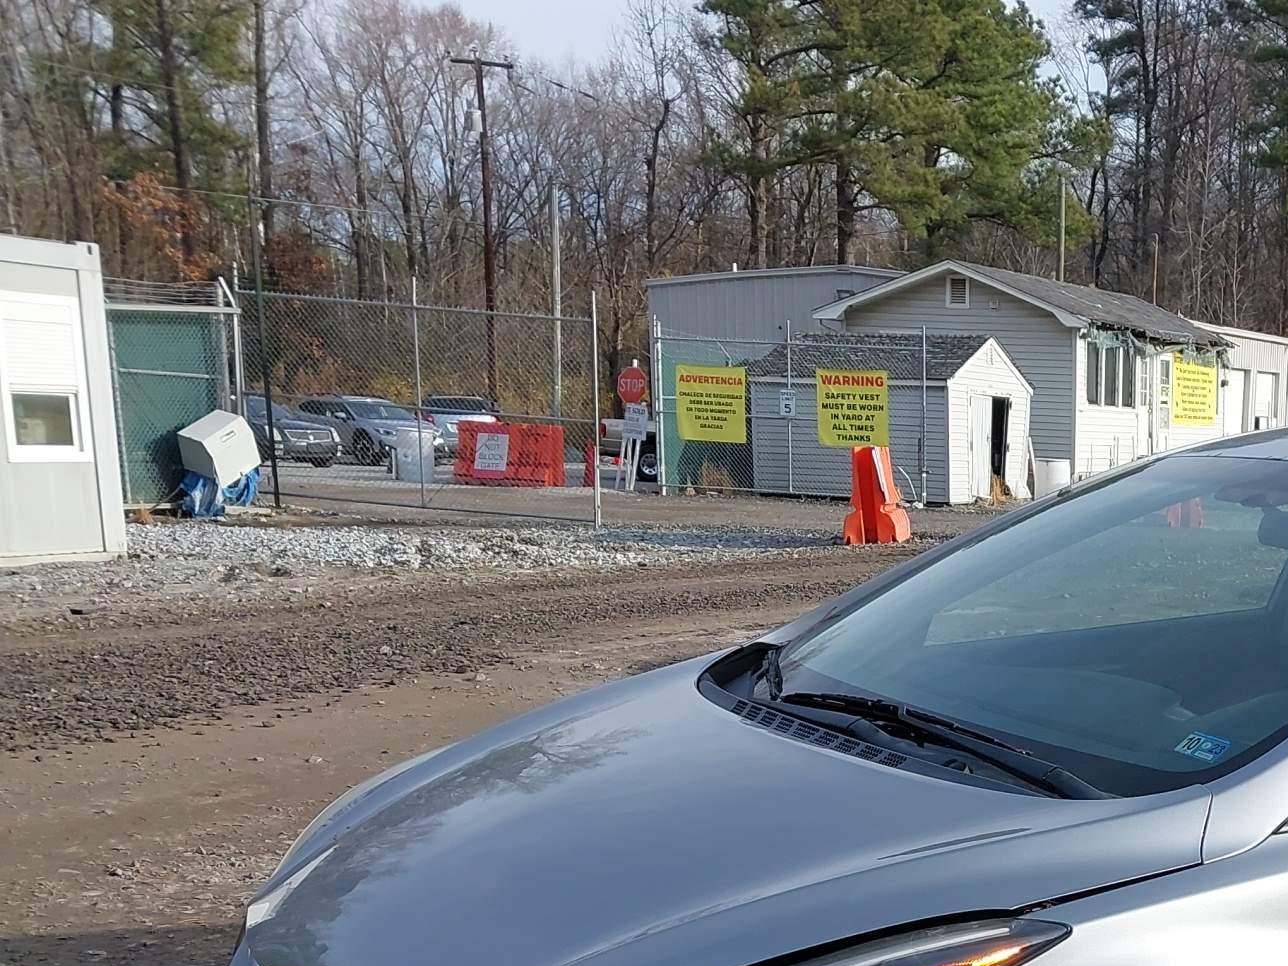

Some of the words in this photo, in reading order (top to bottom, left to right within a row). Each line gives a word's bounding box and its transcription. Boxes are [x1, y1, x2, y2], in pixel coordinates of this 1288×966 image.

[620, 378, 644, 392] STOP
[679, 374, 743, 385] ADVERTENCIA
[820, 374, 884, 387] WARNING
[825, 392, 856, 400] SAFETY
[859, 393, 881, 401] VEST
[784, 403, 792, 414] 5
[821, 402, 845, 410] MUST
[859, 404, 884, 412] WORN
[832, 423, 848, 431] ALL
[849, 424, 875, 432] TIMES
[836, 433, 871, 442] THANKS
[1182, 736, 1202, 750] 10
